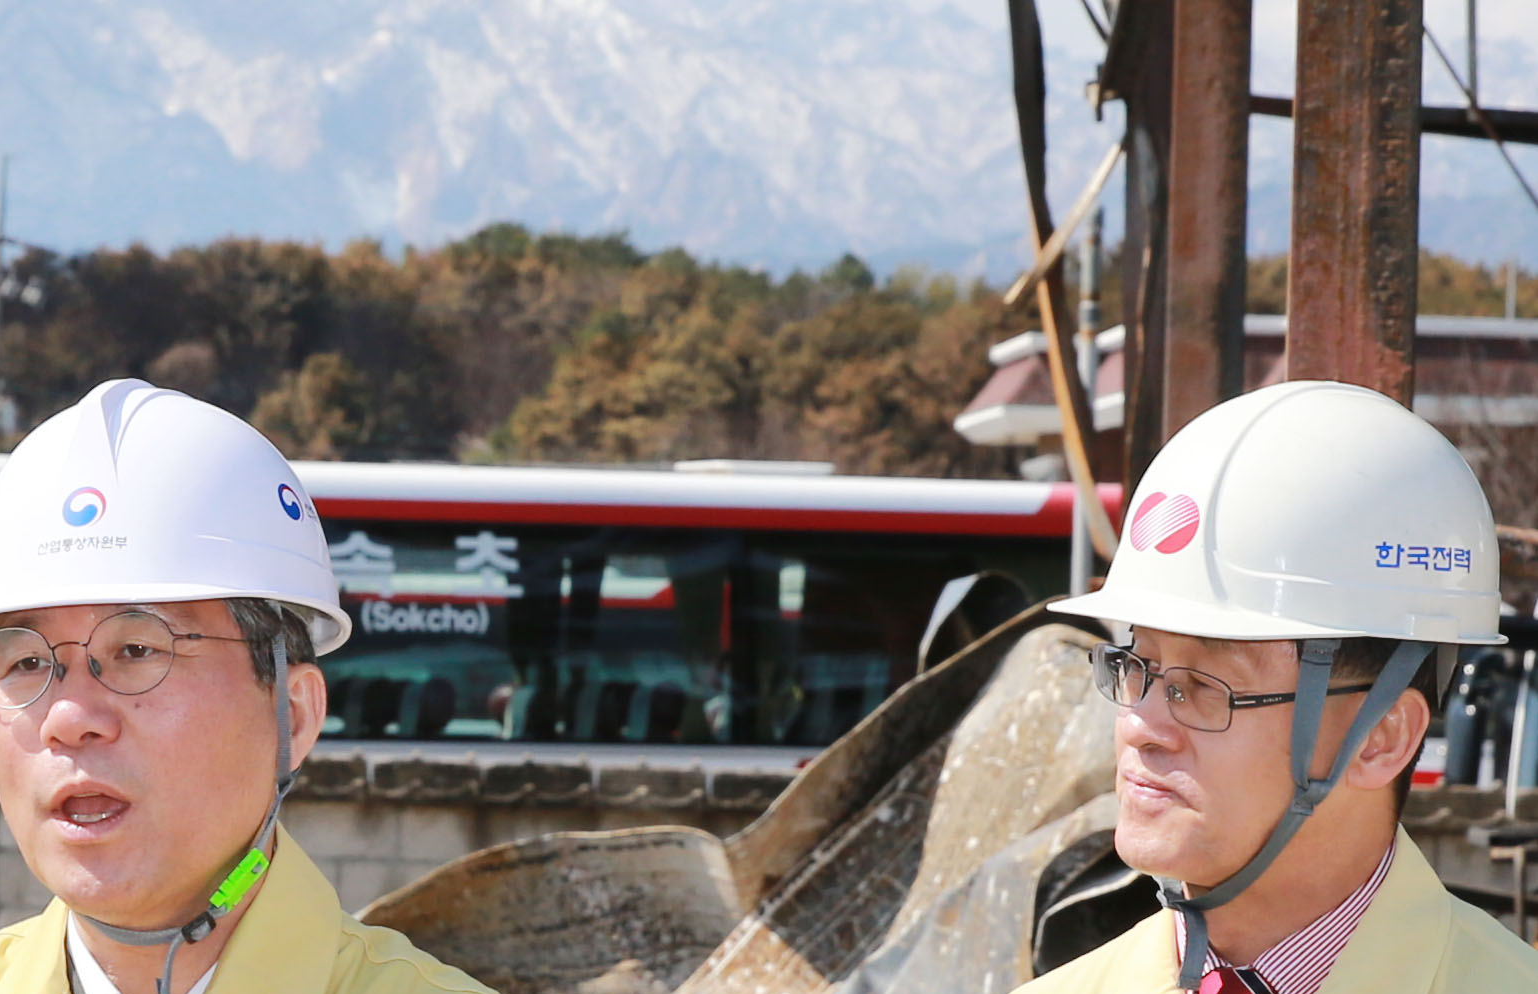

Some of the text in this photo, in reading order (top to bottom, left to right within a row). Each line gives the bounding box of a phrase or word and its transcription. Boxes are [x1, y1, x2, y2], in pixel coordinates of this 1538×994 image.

[37, 535, 128, 556] 산업통상자원부
[1375, 541, 1472, 574] 한국전력
[361, 600, 490, 635] (Sokcho)
